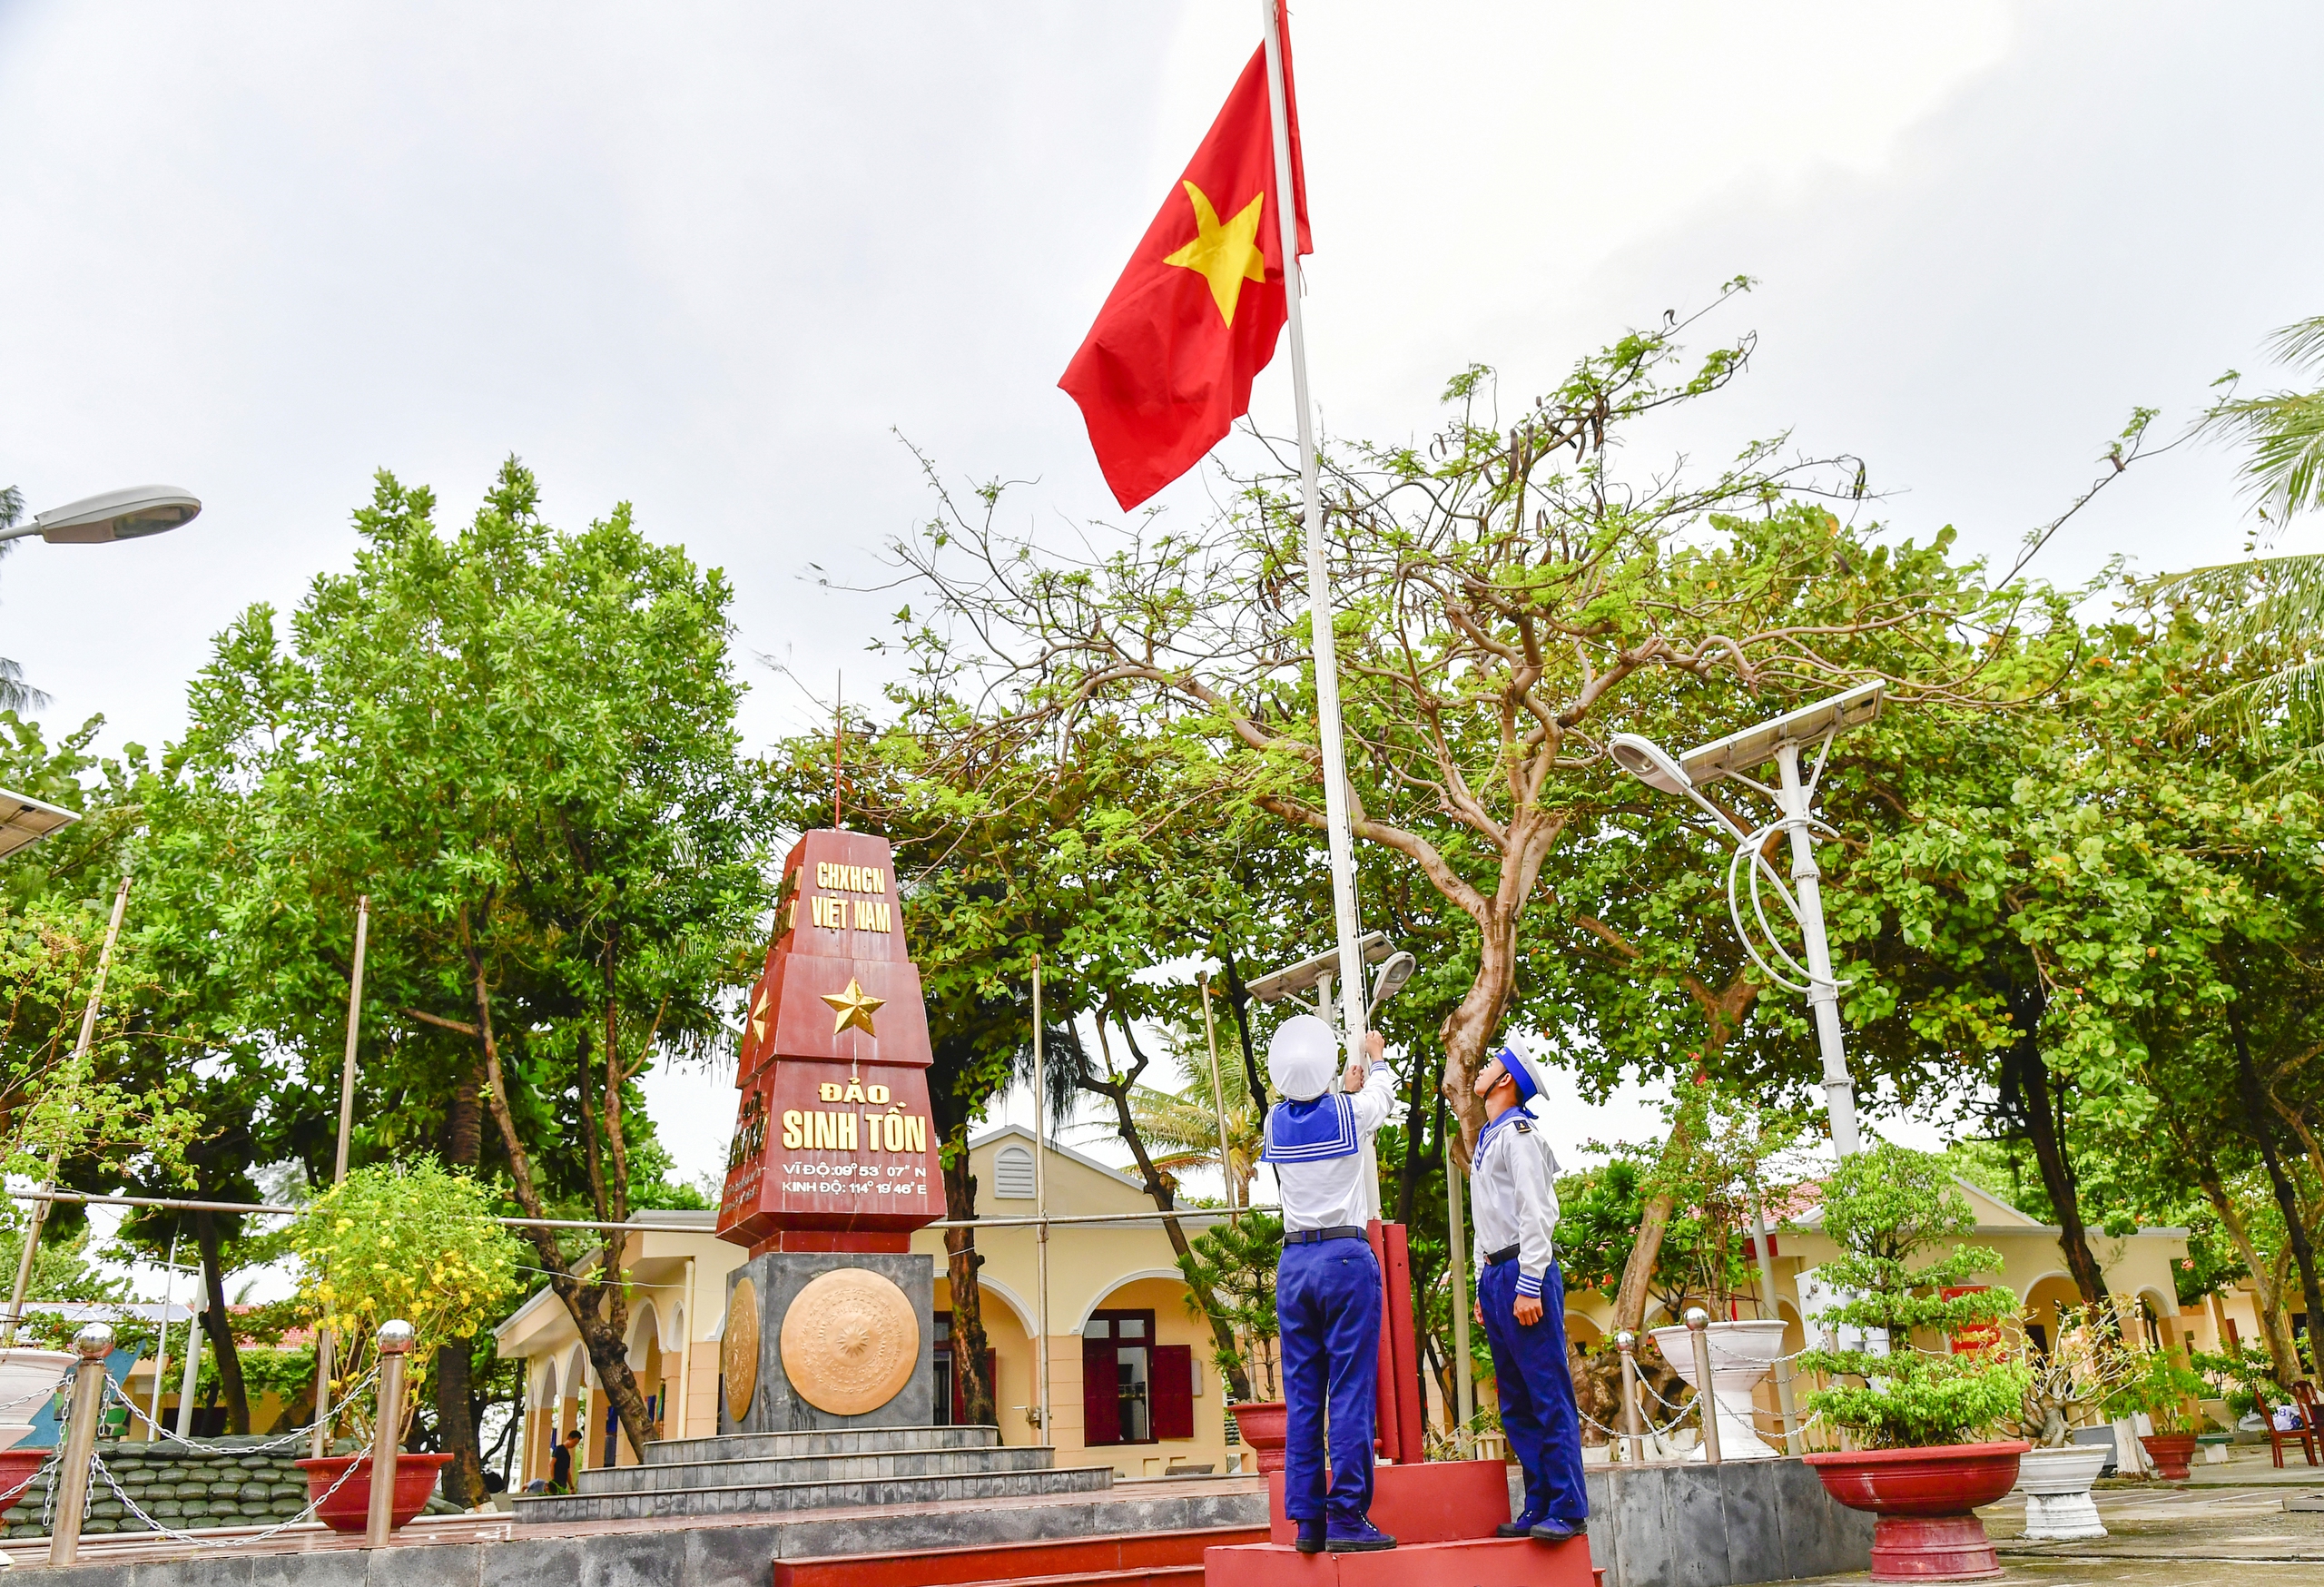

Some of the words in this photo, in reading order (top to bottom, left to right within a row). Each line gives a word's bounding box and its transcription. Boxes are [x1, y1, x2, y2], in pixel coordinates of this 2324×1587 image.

[817, 862, 885, 894] CHXHCN
[811, 892, 848, 933] VIỆT
[854, 900, 891, 933] NAM
[818, 1077, 891, 1105] ĐẢO
[783, 1109, 859, 1150] SINH
[782, 1181, 817, 1192] KINH
[819, 1178, 846, 1195] ĐỘ:
[917, 1184, 927, 1195] E
[914, 1167, 927, 1178] N
